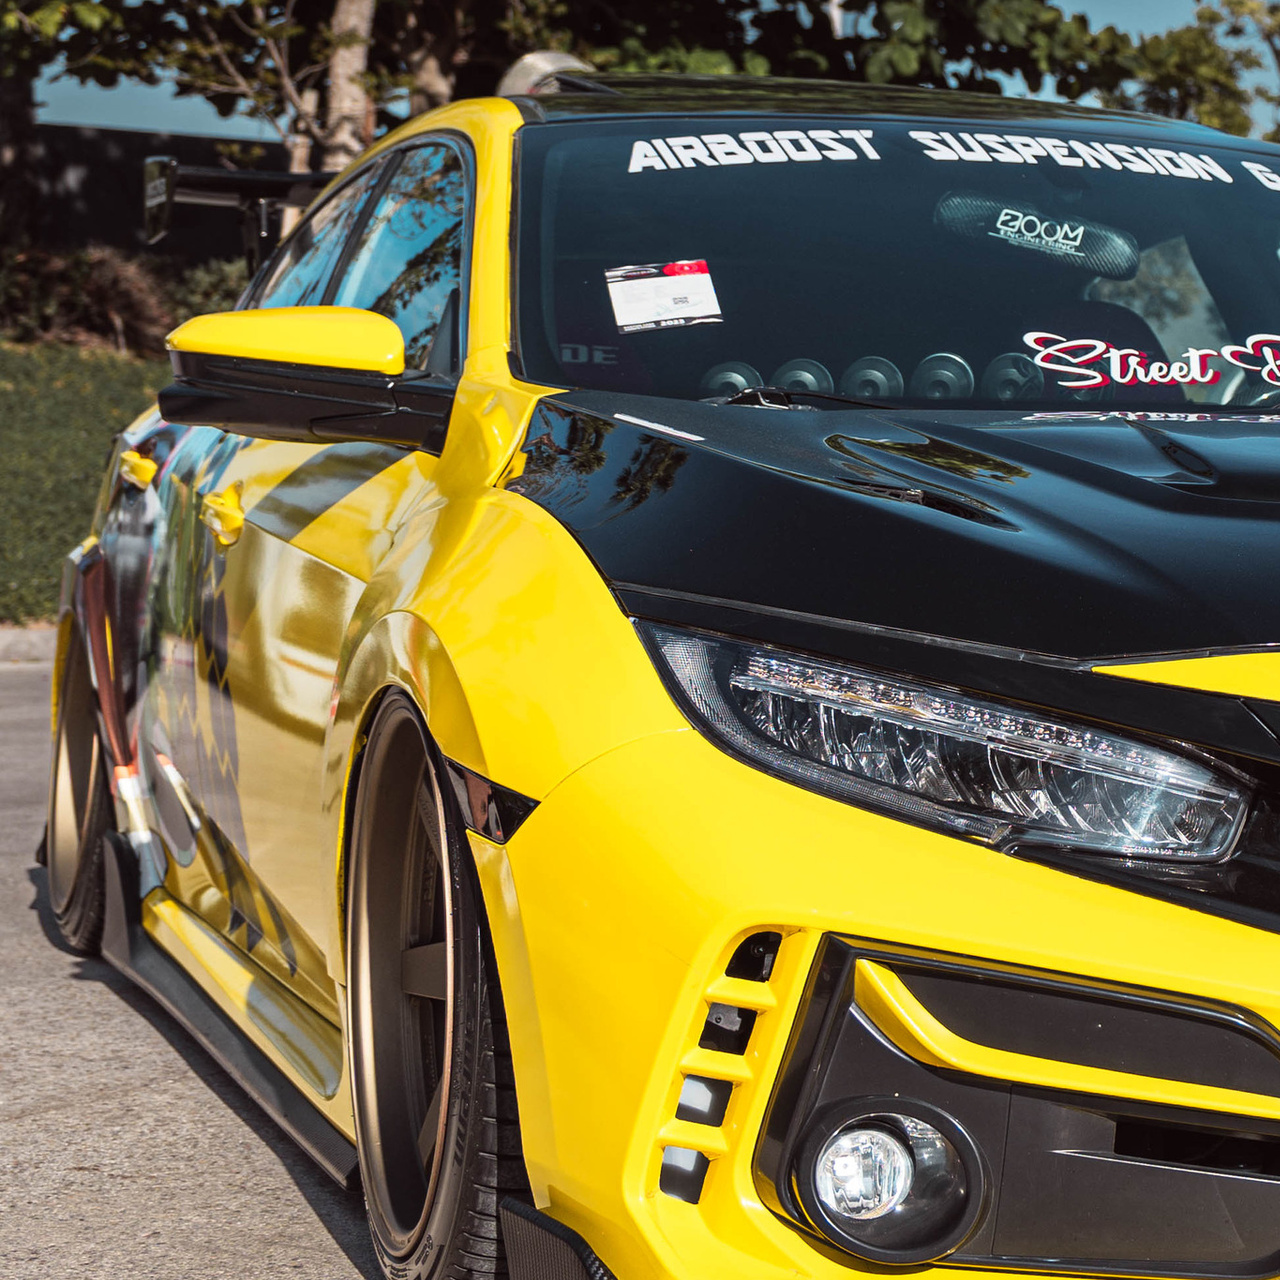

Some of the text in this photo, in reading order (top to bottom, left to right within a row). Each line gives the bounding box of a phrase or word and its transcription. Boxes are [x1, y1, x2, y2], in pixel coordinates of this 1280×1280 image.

[628, 129, 882, 173] AIRBOOST
[908, 131, 1233, 183] SUSPENSION
[996, 209, 1085, 246] ZOOM
[1023, 331, 1221, 389] Street
